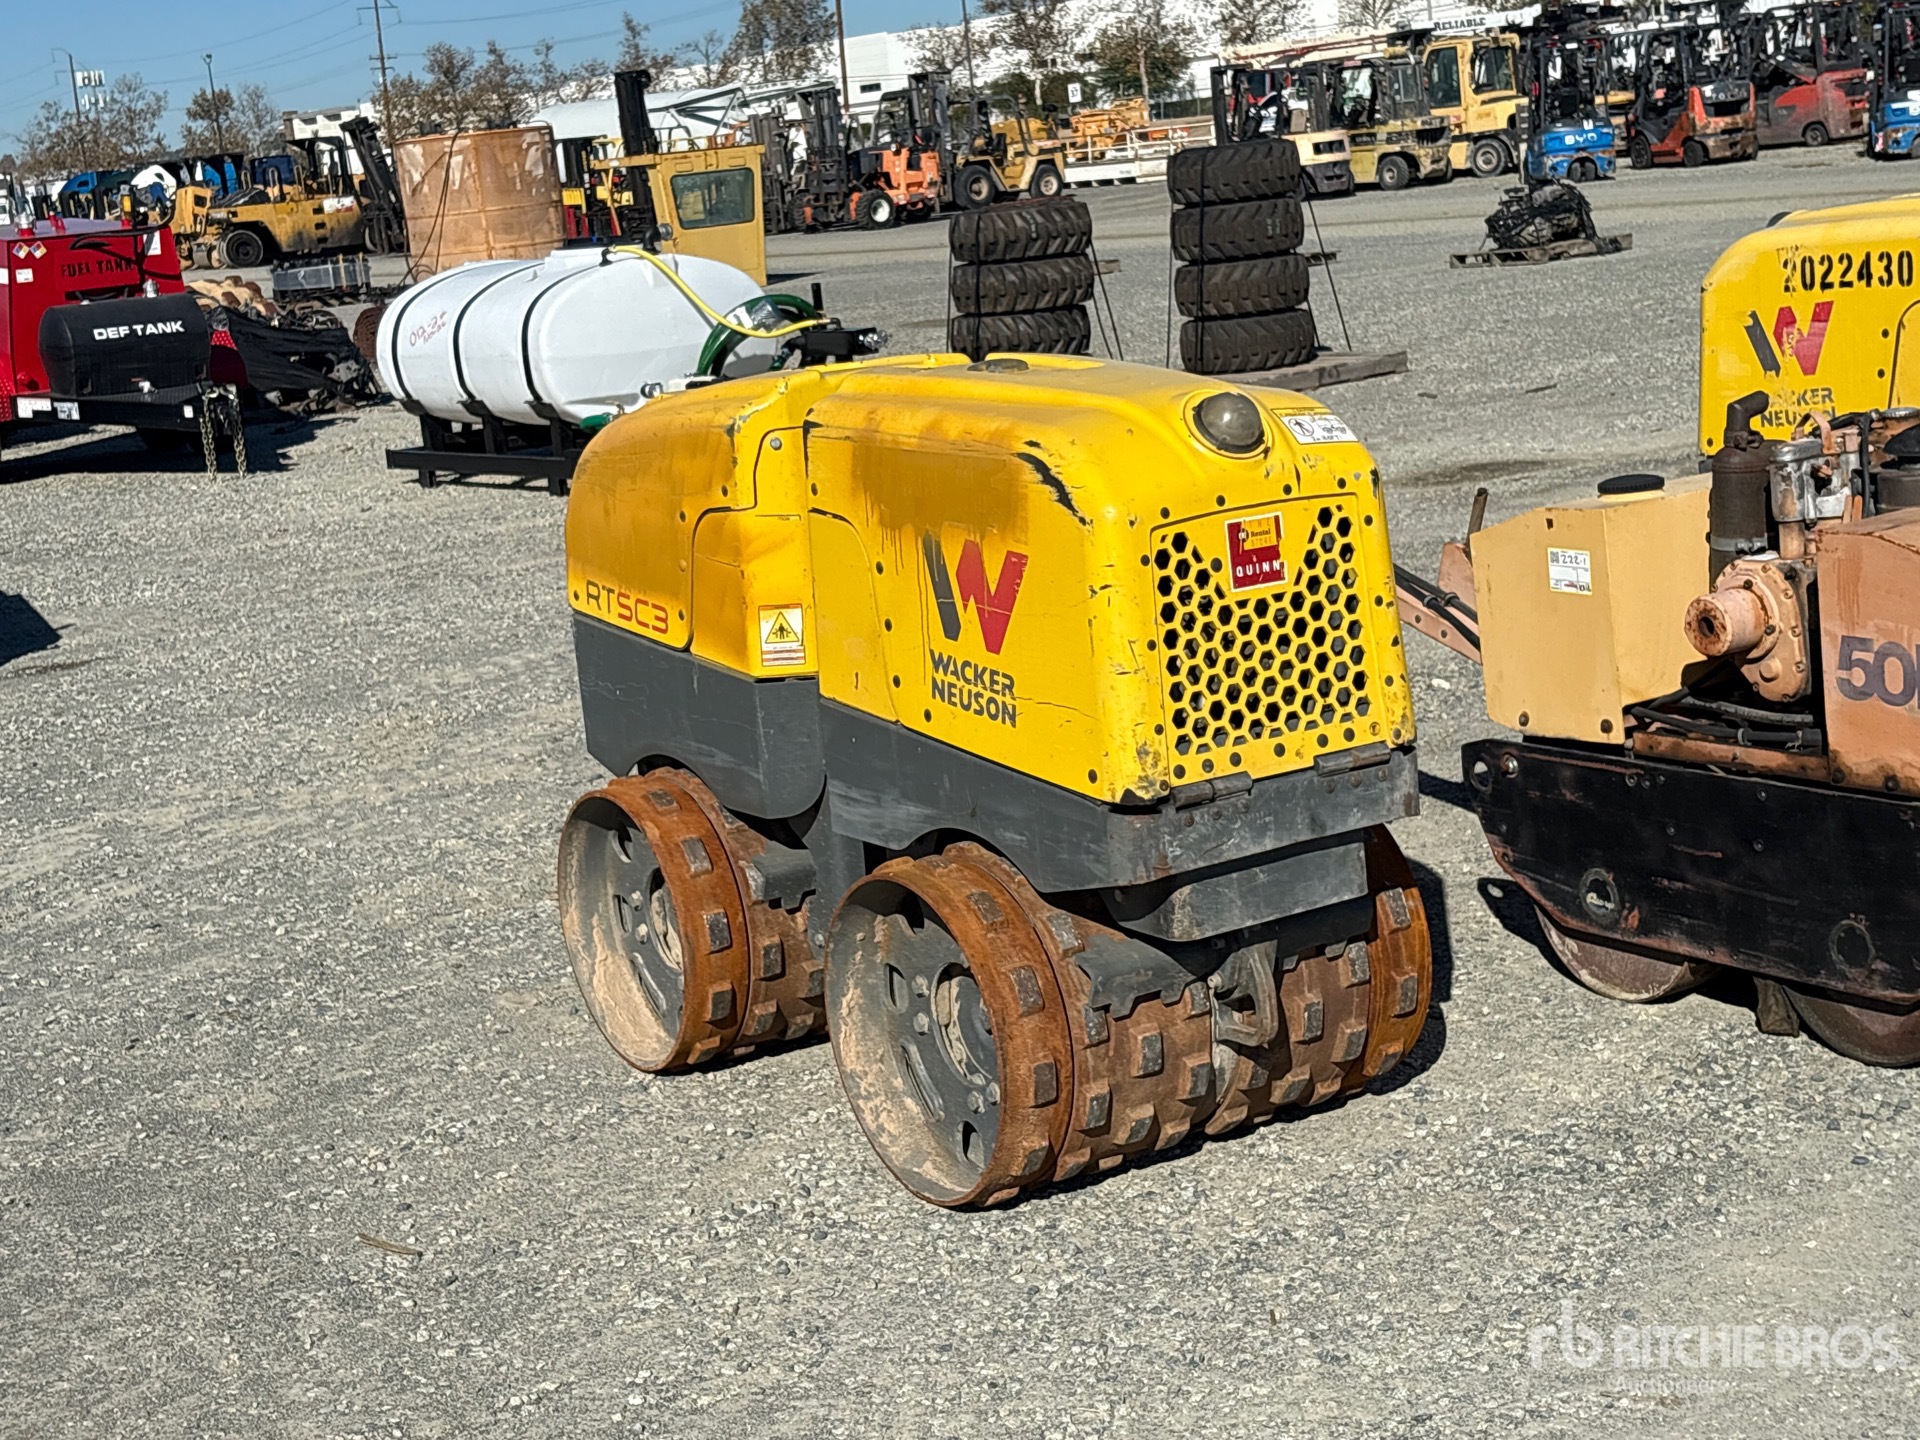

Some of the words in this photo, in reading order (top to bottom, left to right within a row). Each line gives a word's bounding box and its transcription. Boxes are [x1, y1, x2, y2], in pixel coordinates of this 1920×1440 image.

[1433, 17, 1487, 31] RELIABLE
[61, 263, 91, 278] FUEL
[1782, 250, 1914, 293] 2022430
[93, 325, 130, 341] DEF
[132, 320, 185, 336] TANK
[1250, 528, 1271, 538] Rental
[1235, 559, 1281, 577] QUINN
[930, 648, 1016, 701] WACKER
[1835, 634, 1920, 710] 50
[931, 676, 1017, 729] NEUSON
